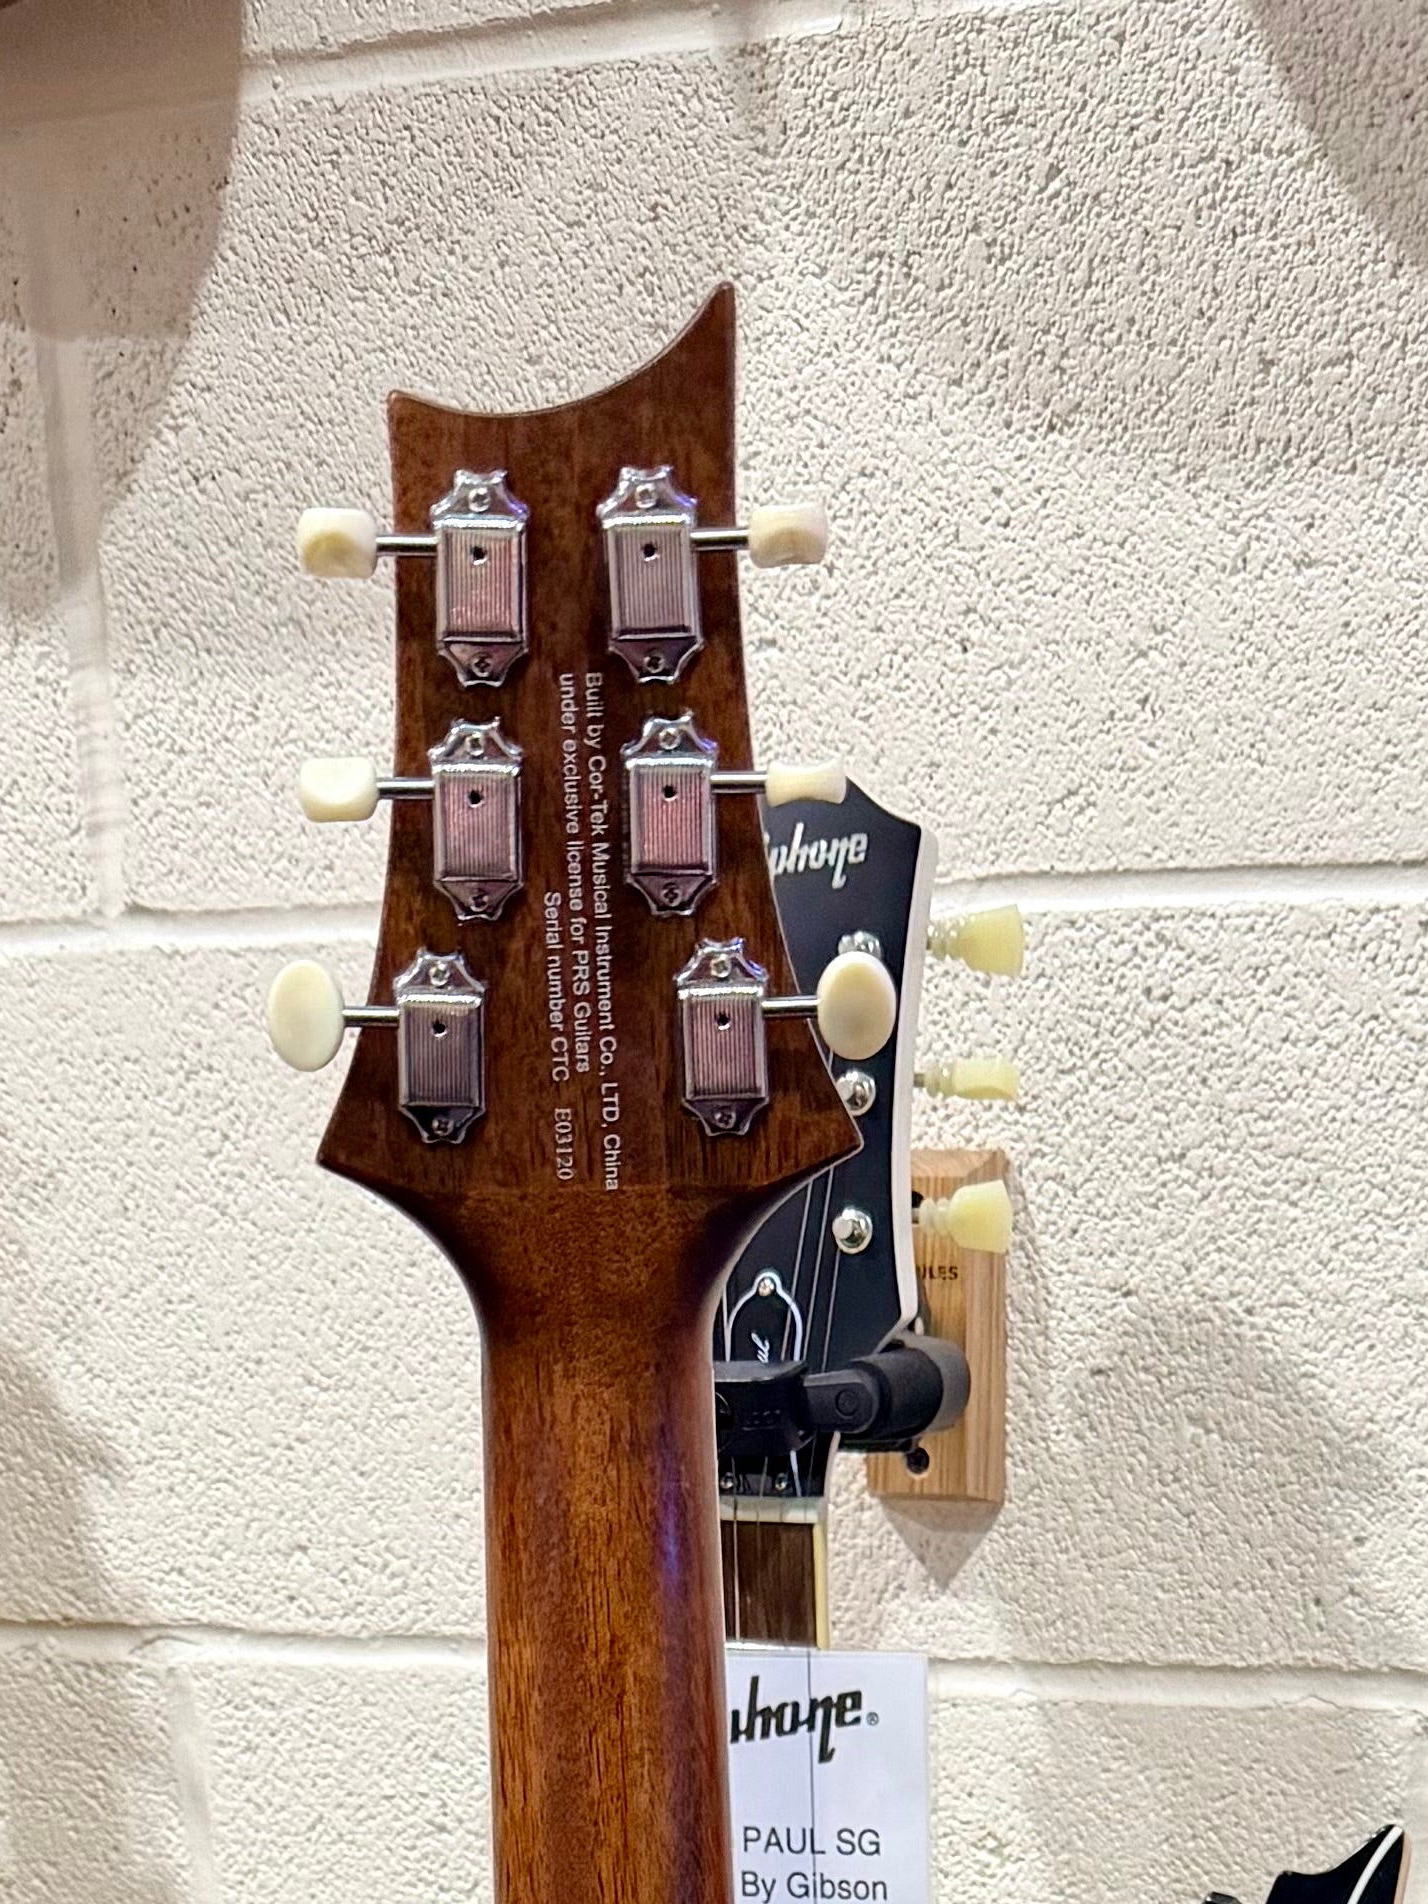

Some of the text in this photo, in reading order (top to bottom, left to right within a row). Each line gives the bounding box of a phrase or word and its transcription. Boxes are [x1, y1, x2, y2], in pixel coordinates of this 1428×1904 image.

[584, 672, 604, 718] Built
[583, 724, 604, 749] by
[587, 755, 609, 836] Cor-Tek
[559, 673, 592, 1073] under exclusive license for PRS Guitars
[591, 842, 613, 919] Musical
[544, 891, 564, 949] Serial
[547, 955, 567, 1031] number
[595, 925, 615, 1031] Instrument
[551, 1036, 570, 1082] CTC
[603, 1134, 621, 1190] China
[742, 1826, 882, 1857] PAUL SG
[740, 1871, 887, 1904] By Gibson
